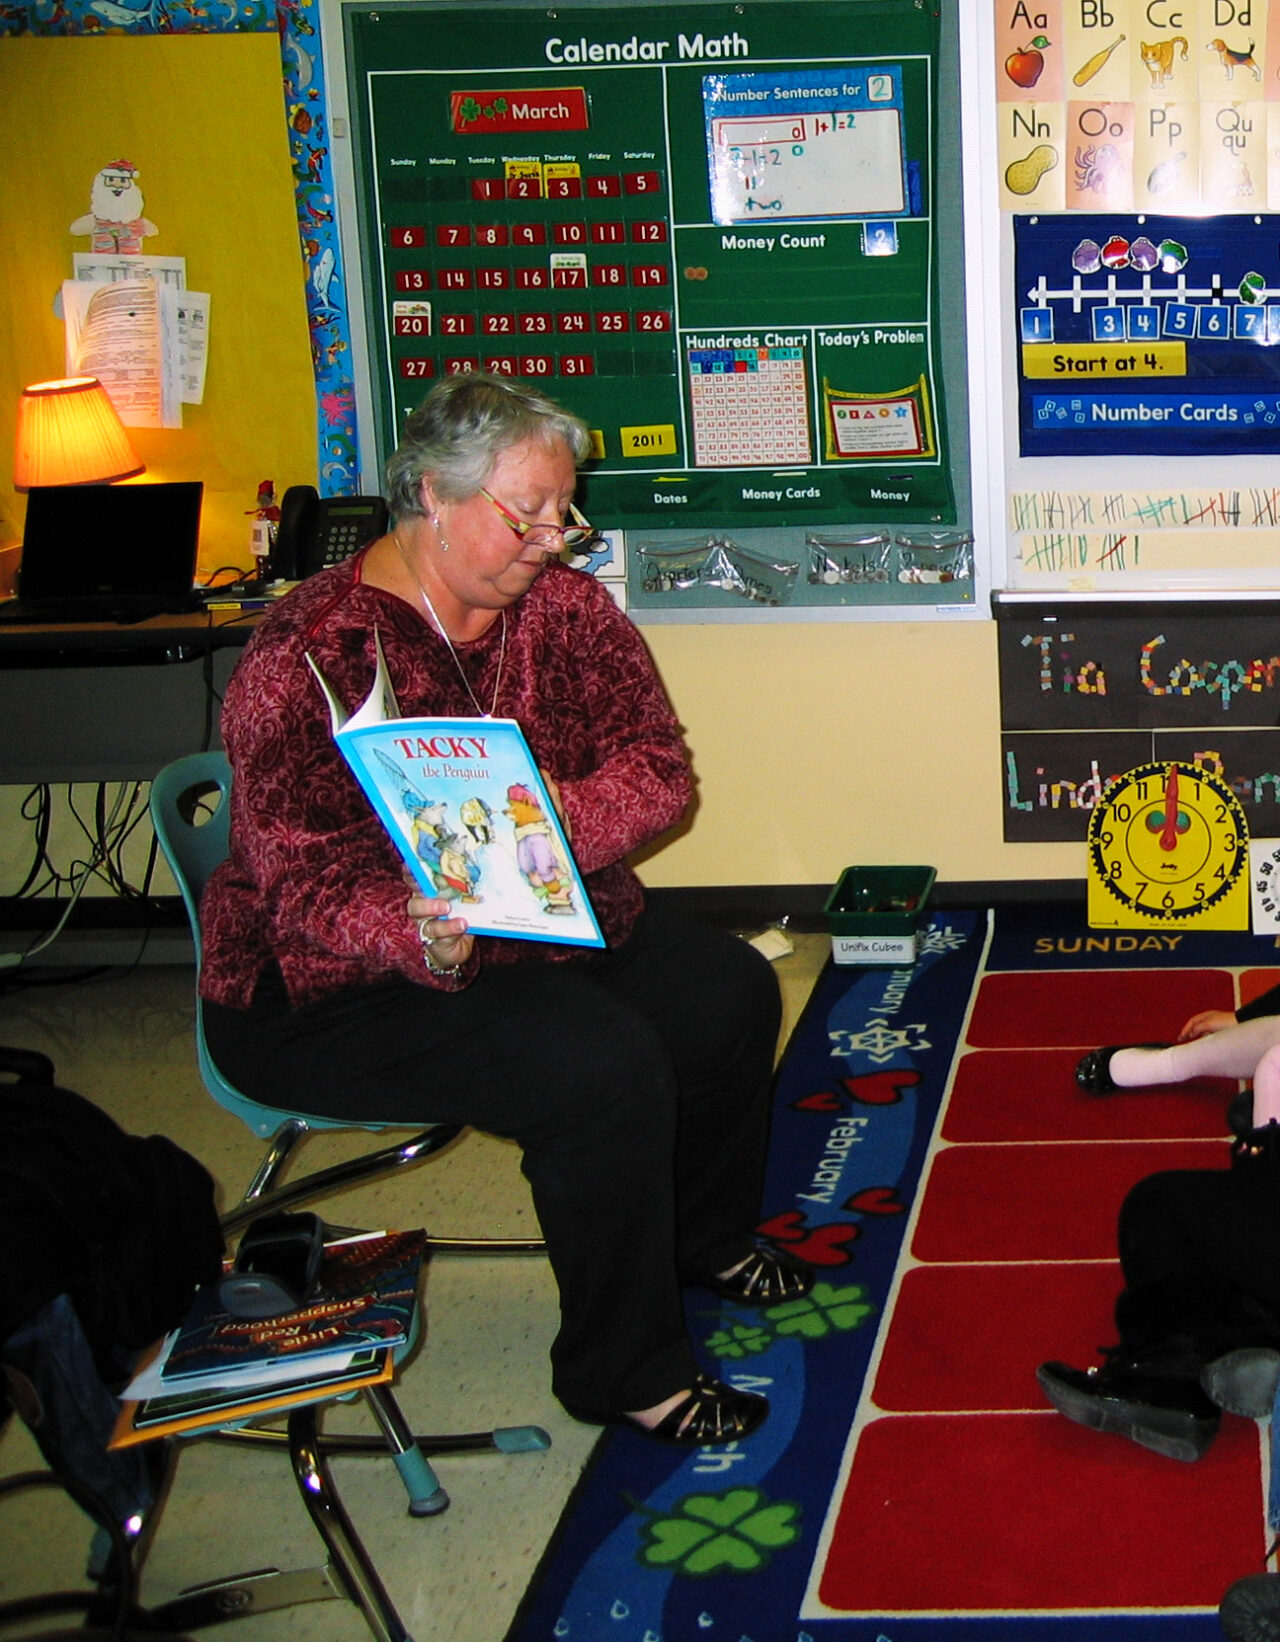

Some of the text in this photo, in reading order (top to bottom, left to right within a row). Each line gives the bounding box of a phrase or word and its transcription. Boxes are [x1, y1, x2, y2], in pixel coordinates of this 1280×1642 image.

[1010, 1, 1048, 29] Aa
[1081, 1, 1114, 27] Bb
[1146, 1, 1183, 29] Cc
[1214, 0, 1251, 26] Dd
[545, 33, 748, 63] Calendar Math
[717, 84, 860, 102] Number Sentences for
[872, 78, 888, 97] 2
[511, 103, 569, 120] March
[1012, 109, 1050, 138] Nn
[1078, 109, 1124, 137] Oo
[1150, 109, 1181, 147] Pp
[1215, 109, 1252, 134] Qu
[1223, 134, 1246, 156] qu
[486, 176, 646, 196] 1 2 3 4 5
[404, 225, 659, 243] 6 7 8 9 10 11 12
[722, 235, 826, 250] Money Count
[876, 229, 887, 246] 2
[405, 269, 660, 288] 13 14 15 16 17 18 19
[1033, 316, 1039, 334] 1
[1103, 316, 1115, 332] 3
[1138, 315, 1150, 331] 4
[1174, 312, 1187, 329] 5
[1208, 315, 1220, 331] 6
[1244, 315, 1256, 331] 7
[686, 333, 807, 348] Hundreds Chart
[818, 330, 924, 346] Today's Problem
[1053, 354, 1164, 373] Start at 4.
[1091, 404, 1238, 422] Number Cards
[632, 434, 662, 447] 2011
[654, 493, 688, 504] Dates
[742, 488, 820, 501] Money Cards
[870, 489, 910, 502] Money
[1021, 634, 1107, 695] Tia
[394, 737, 490, 759] TACKY
[422, 763, 489, 782] the Penguin
[1136, 782, 1147, 800] 11
[1193, 783, 1200, 800] 1
[1112, 804, 1131, 822] 10
[1215, 805, 1227, 823] 2
[1103, 833, 1114, 849] 9
[1224, 834, 1235, 851] 3
[1110, 862, 1122, 879] 8
[1213, 863, 1226, 880] 4
[1261, 863, 1273, 875] 50
[1136, 883, 1149, 900] 7
[1193, 884, 1205, 900] 5
[1257, 881, 1268, 892] 45
[1162, 891, 1174, 908] 6
[1261, 899, 1274, 912] 40
[1034, 935, 1183, 955] SUNDAY
[796, 1118, 868, 1203] February
[260, 1325, 301, 1340] Red
[282, 1326, 339, 1348] Little
